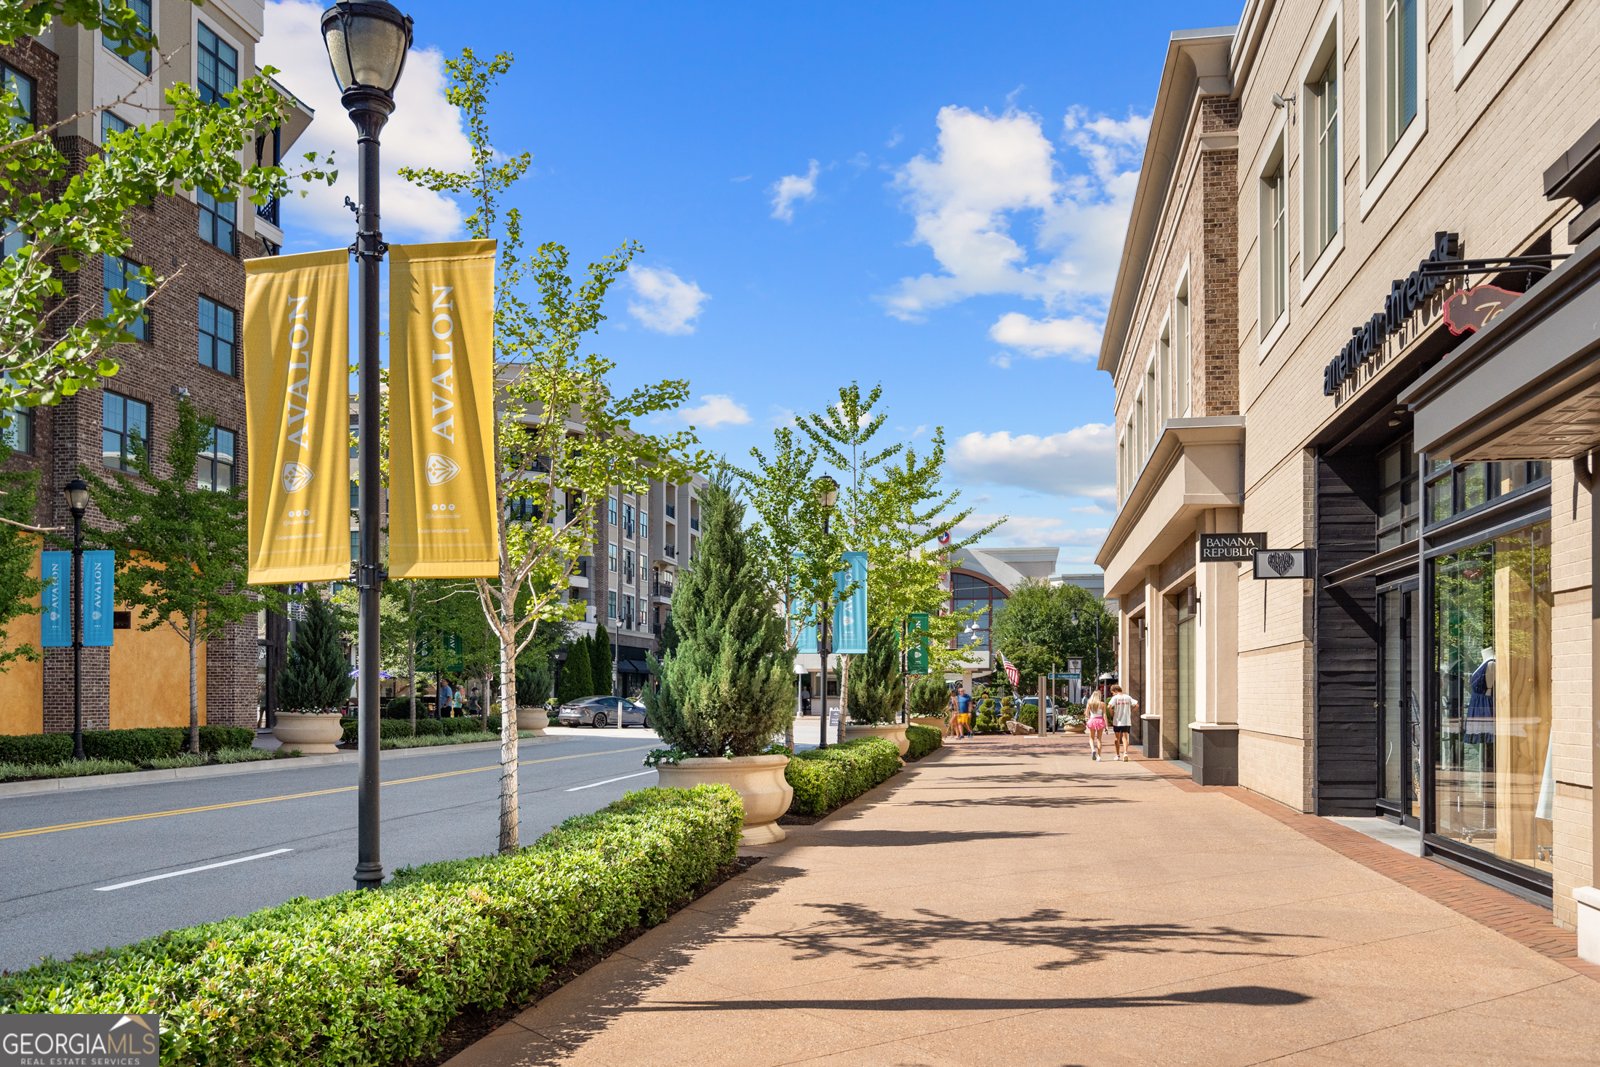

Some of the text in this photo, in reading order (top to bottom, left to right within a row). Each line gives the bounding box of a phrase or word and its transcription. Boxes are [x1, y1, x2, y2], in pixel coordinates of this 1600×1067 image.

[432, 283, 455, 444] AVALON
[1324, 231, 1459, 397] american threads
[287, 295, 310, 449] AVALON
[94, 562, 102, 608] AVALON
[1203, 547, 1259, 558] REPUBLIC
[1206, 537, 1255, 547] BANANA
